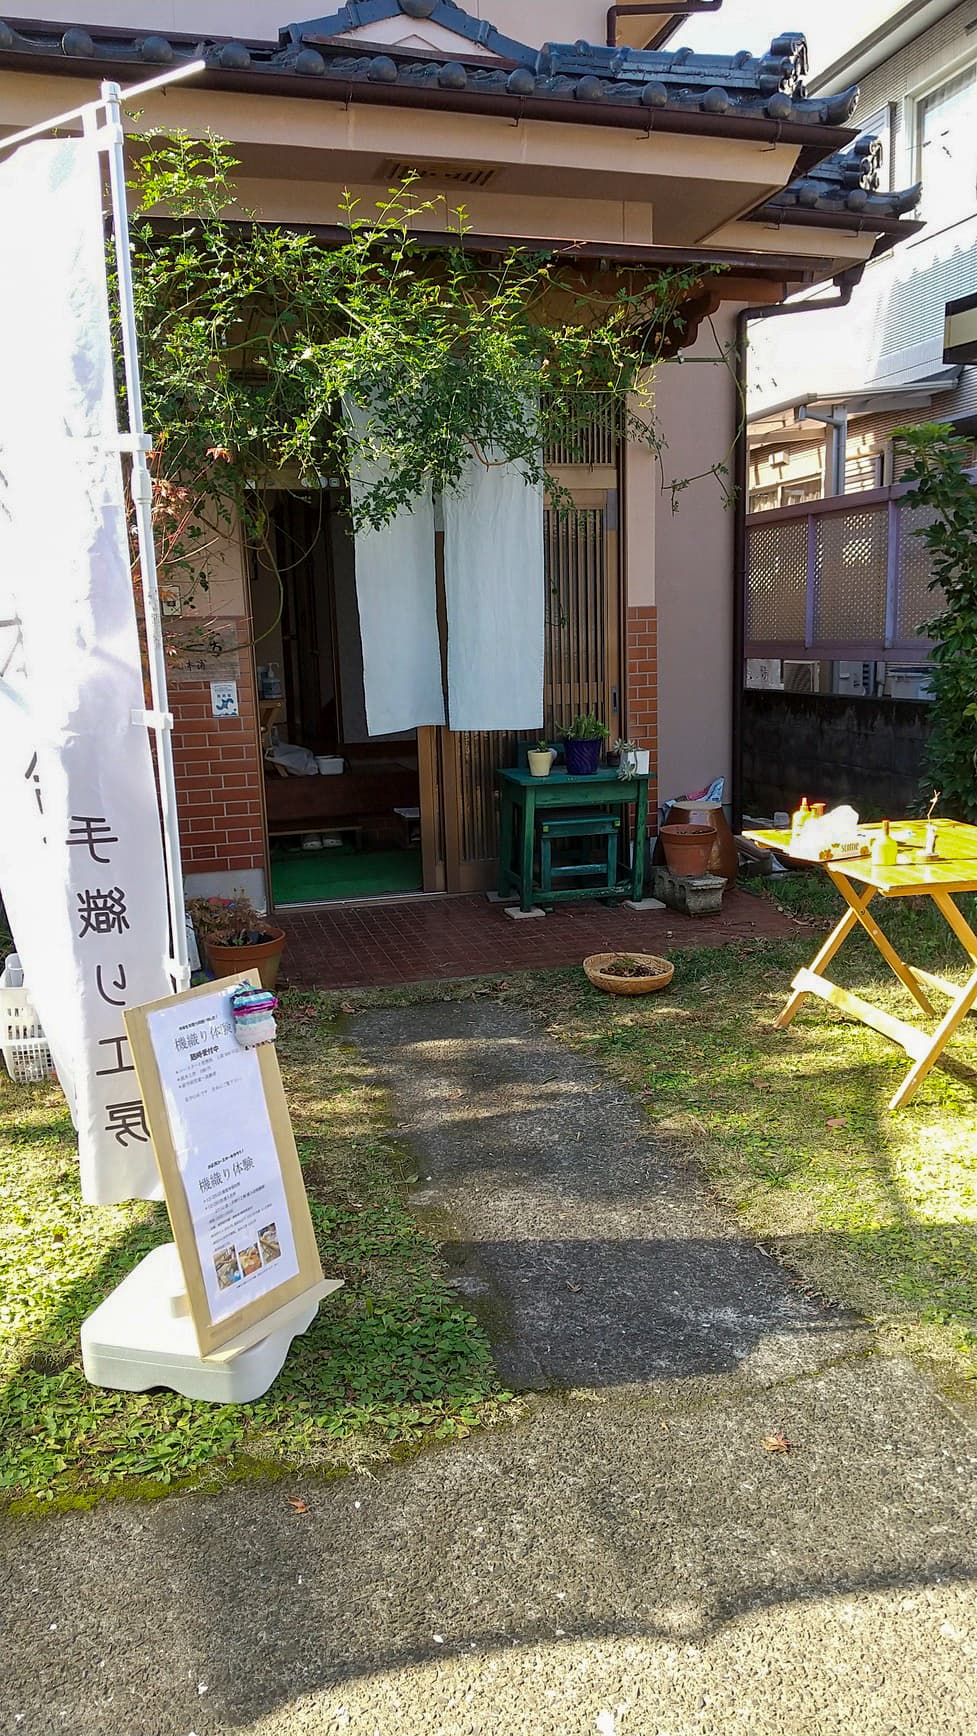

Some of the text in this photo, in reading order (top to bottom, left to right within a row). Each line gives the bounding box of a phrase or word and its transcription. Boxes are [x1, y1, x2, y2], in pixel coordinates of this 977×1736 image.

[175, 1023, 233, 1052] 機織り体験
[198, 1156, 255, 1193] 機織り体験
